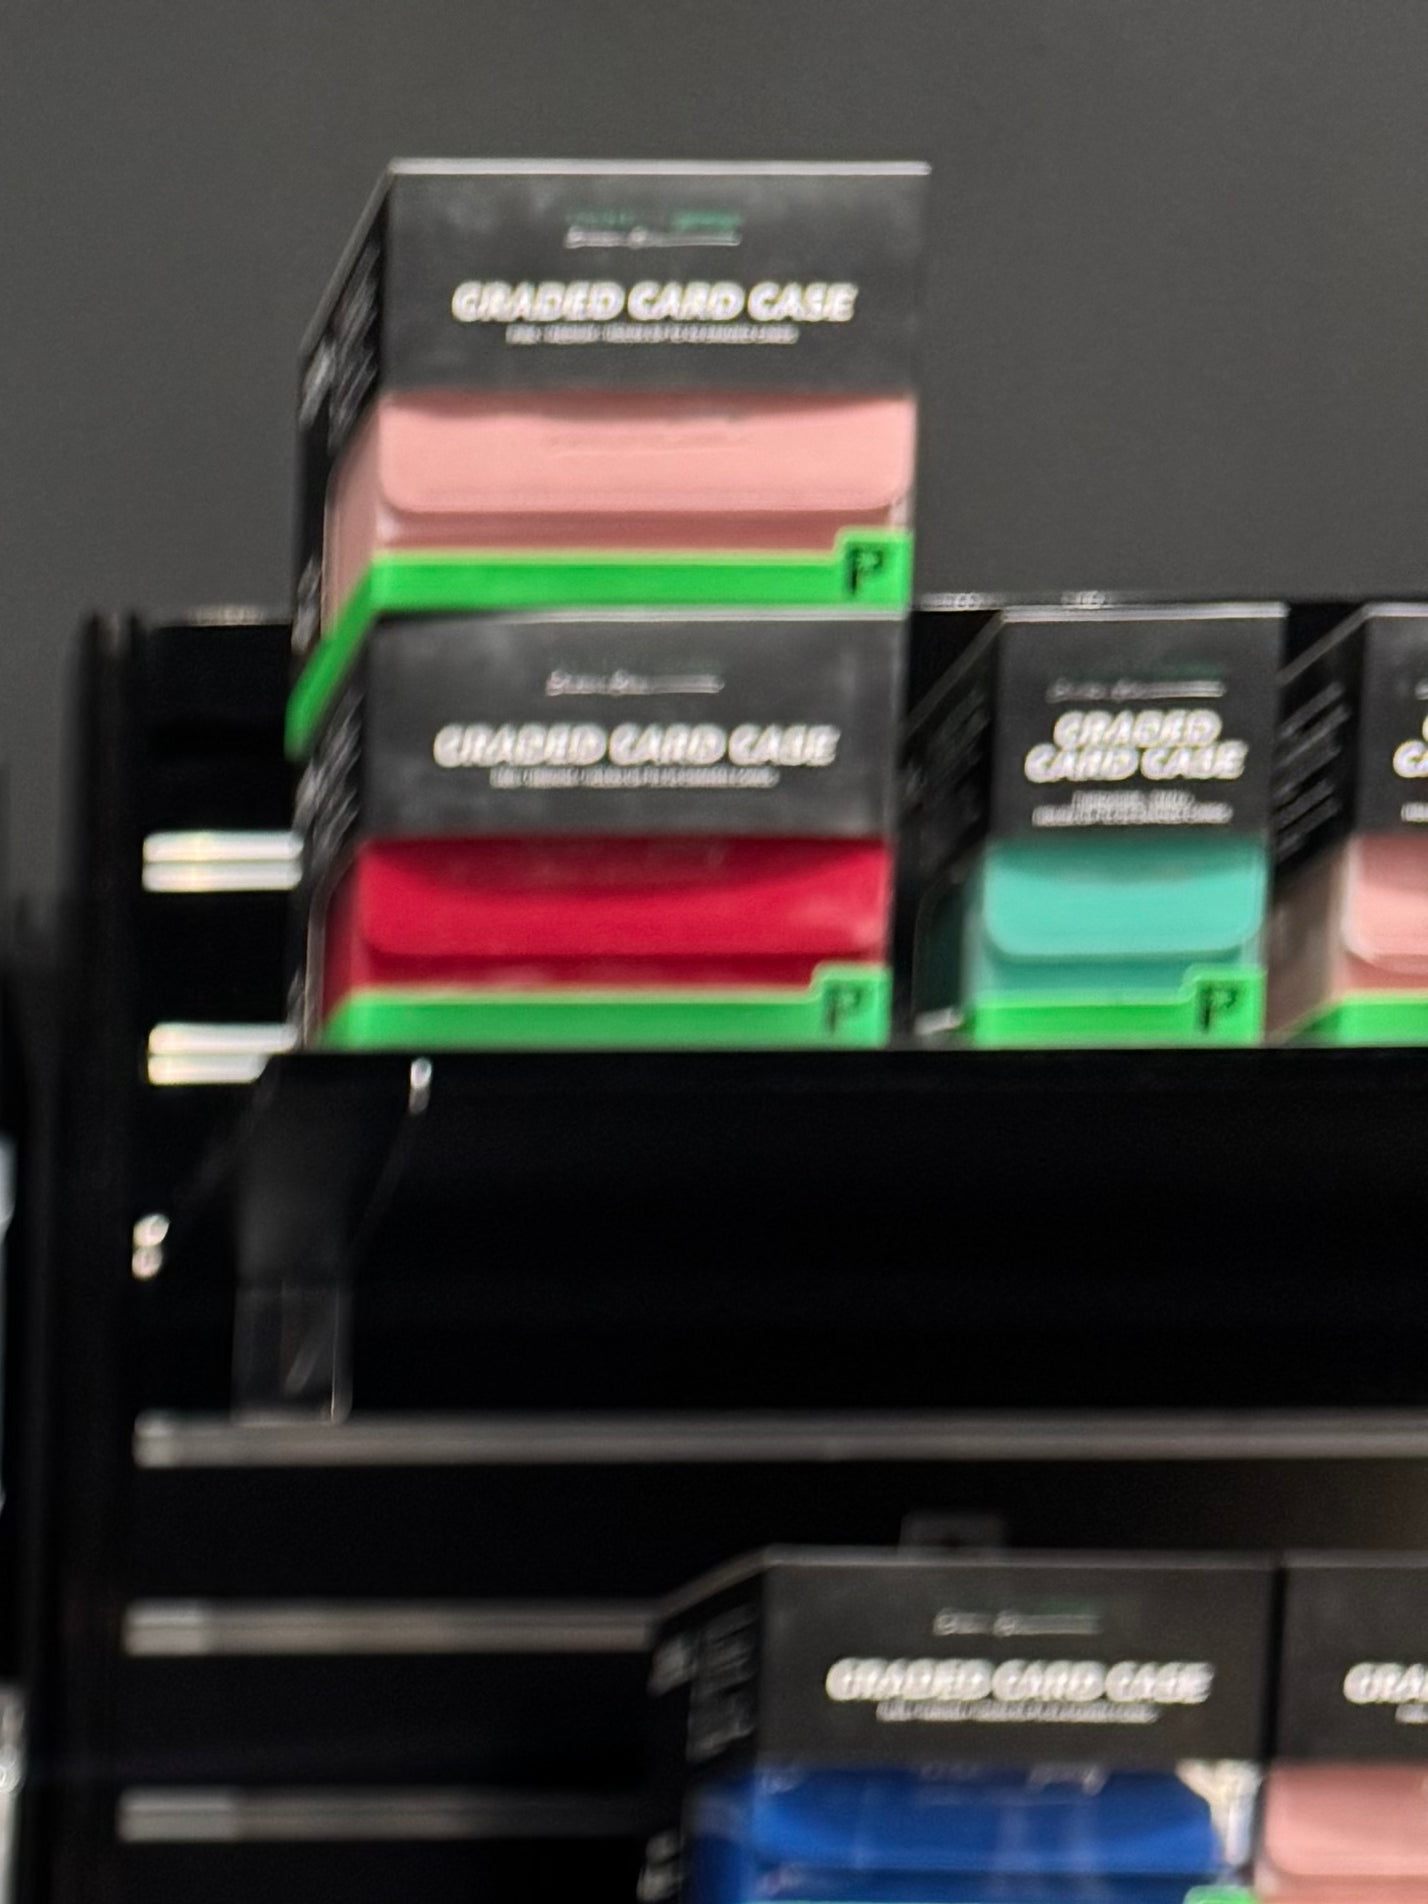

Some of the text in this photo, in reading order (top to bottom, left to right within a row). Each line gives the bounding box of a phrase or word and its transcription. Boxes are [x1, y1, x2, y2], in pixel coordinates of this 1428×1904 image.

[451, 281, 857, 322] GRADED CARD CASE
[609, 724, 727, 767] CARD
[730, 724, 840, 767] CASE
